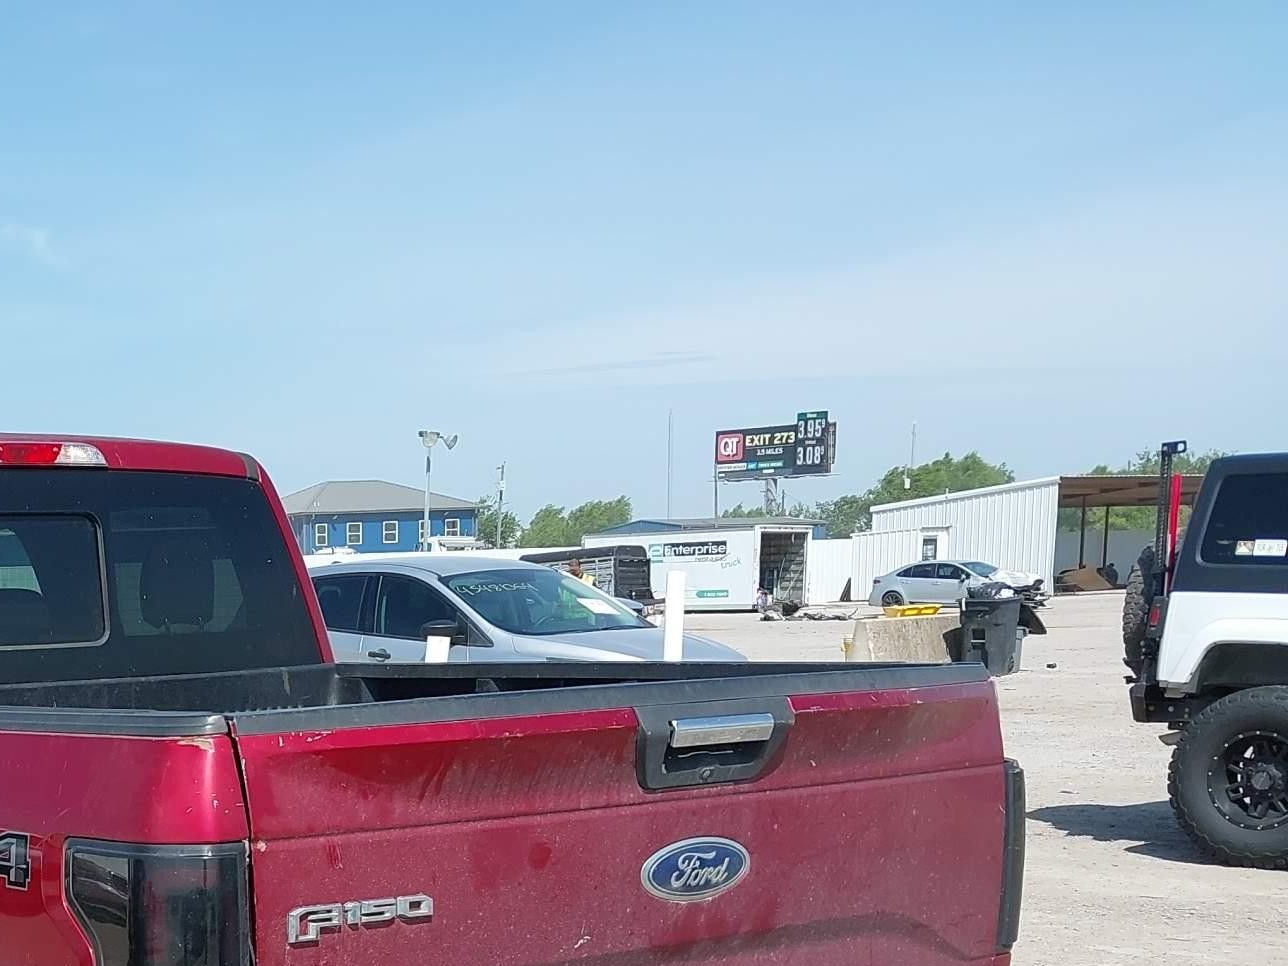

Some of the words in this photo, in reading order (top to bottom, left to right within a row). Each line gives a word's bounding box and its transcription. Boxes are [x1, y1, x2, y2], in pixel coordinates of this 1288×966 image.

[720, 437, 739, 456] QT
[745, 434, 771, 446] EXIT
[773, 432, 795, 444] 273
[664, 543, 727, 555] Enterprise
[671, 851, 730, 888] Ford
